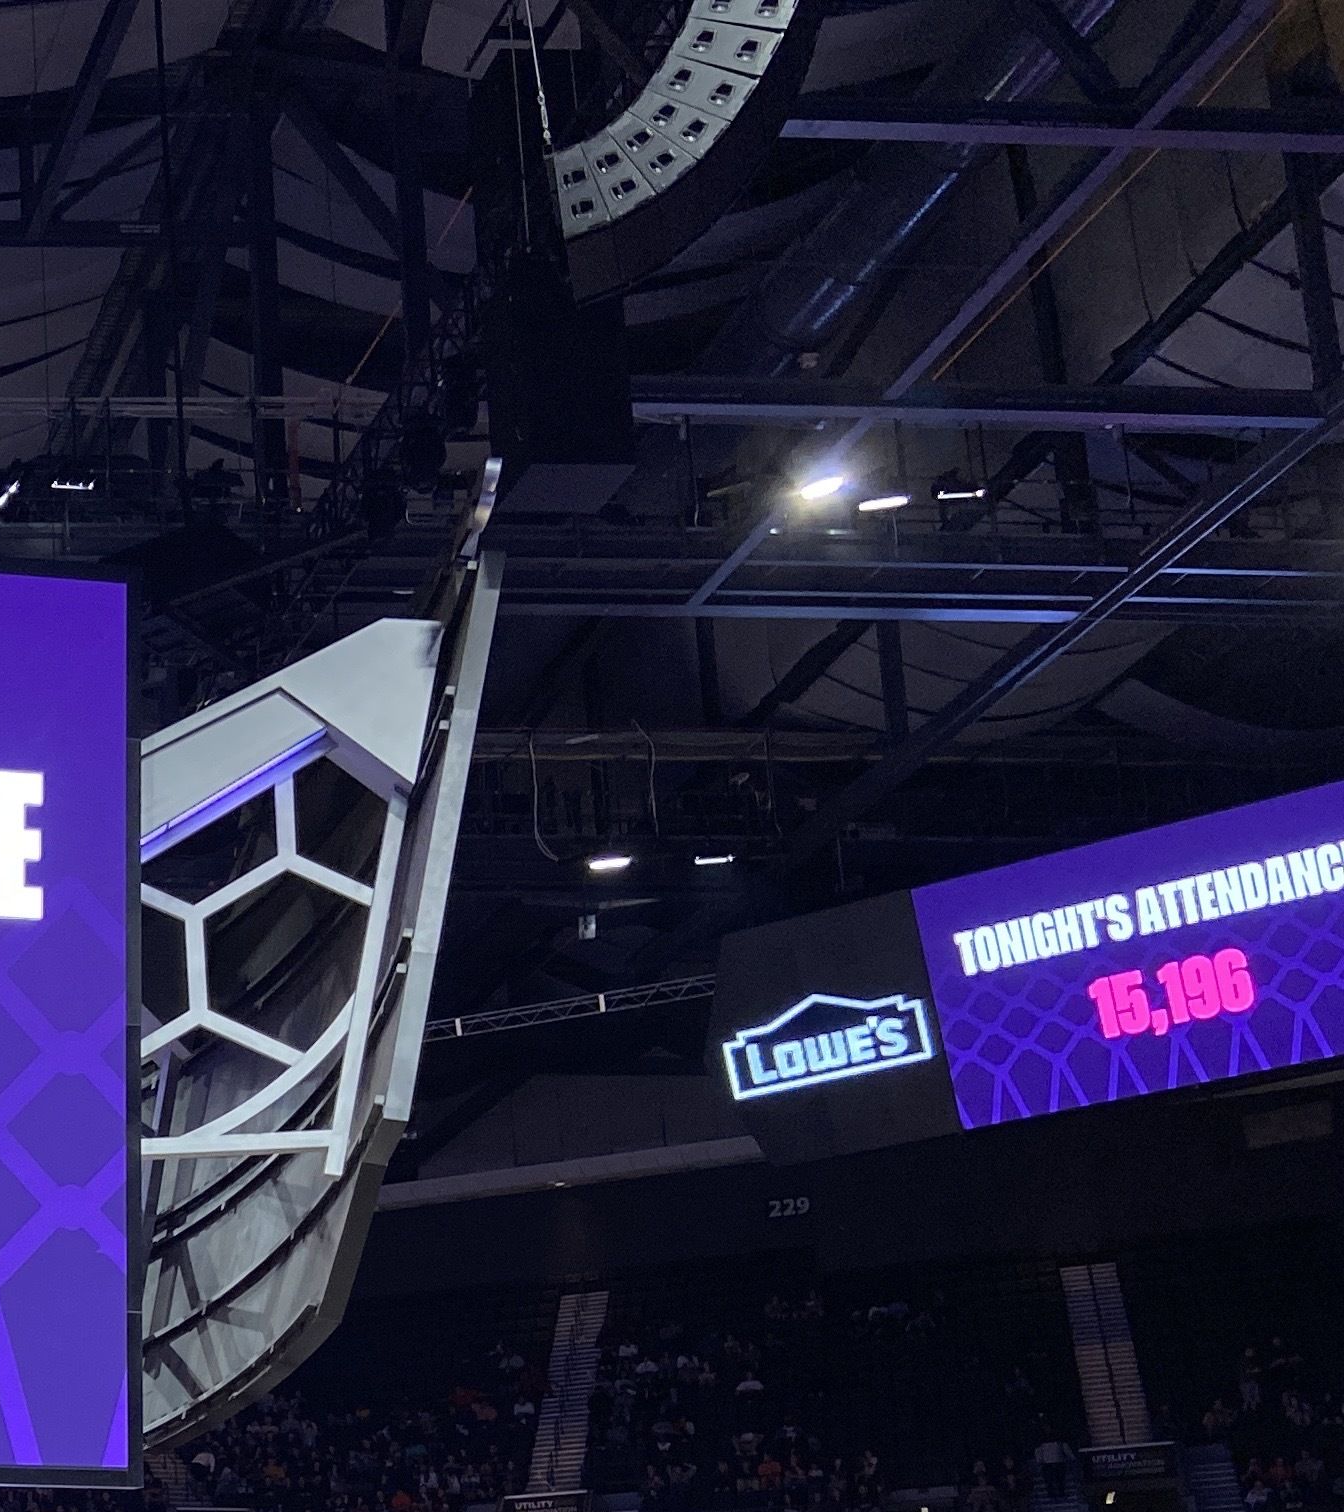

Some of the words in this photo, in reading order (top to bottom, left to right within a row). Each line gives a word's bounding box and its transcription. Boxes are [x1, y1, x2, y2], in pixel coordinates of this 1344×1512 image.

[952, 893, 1134, 978] TONIGHT'S
[1138, 838, 1344, 937] ATTENDANC
[1087, 948, 1255, 1040] 15,196
[746, 1015, 910, 1085] LOWE'S
[768, 1197, 810, 1219] 229
[1091, 1451, 1137, 1465] UTILITY
[514, 1499, 554, 1511] UTILITY
